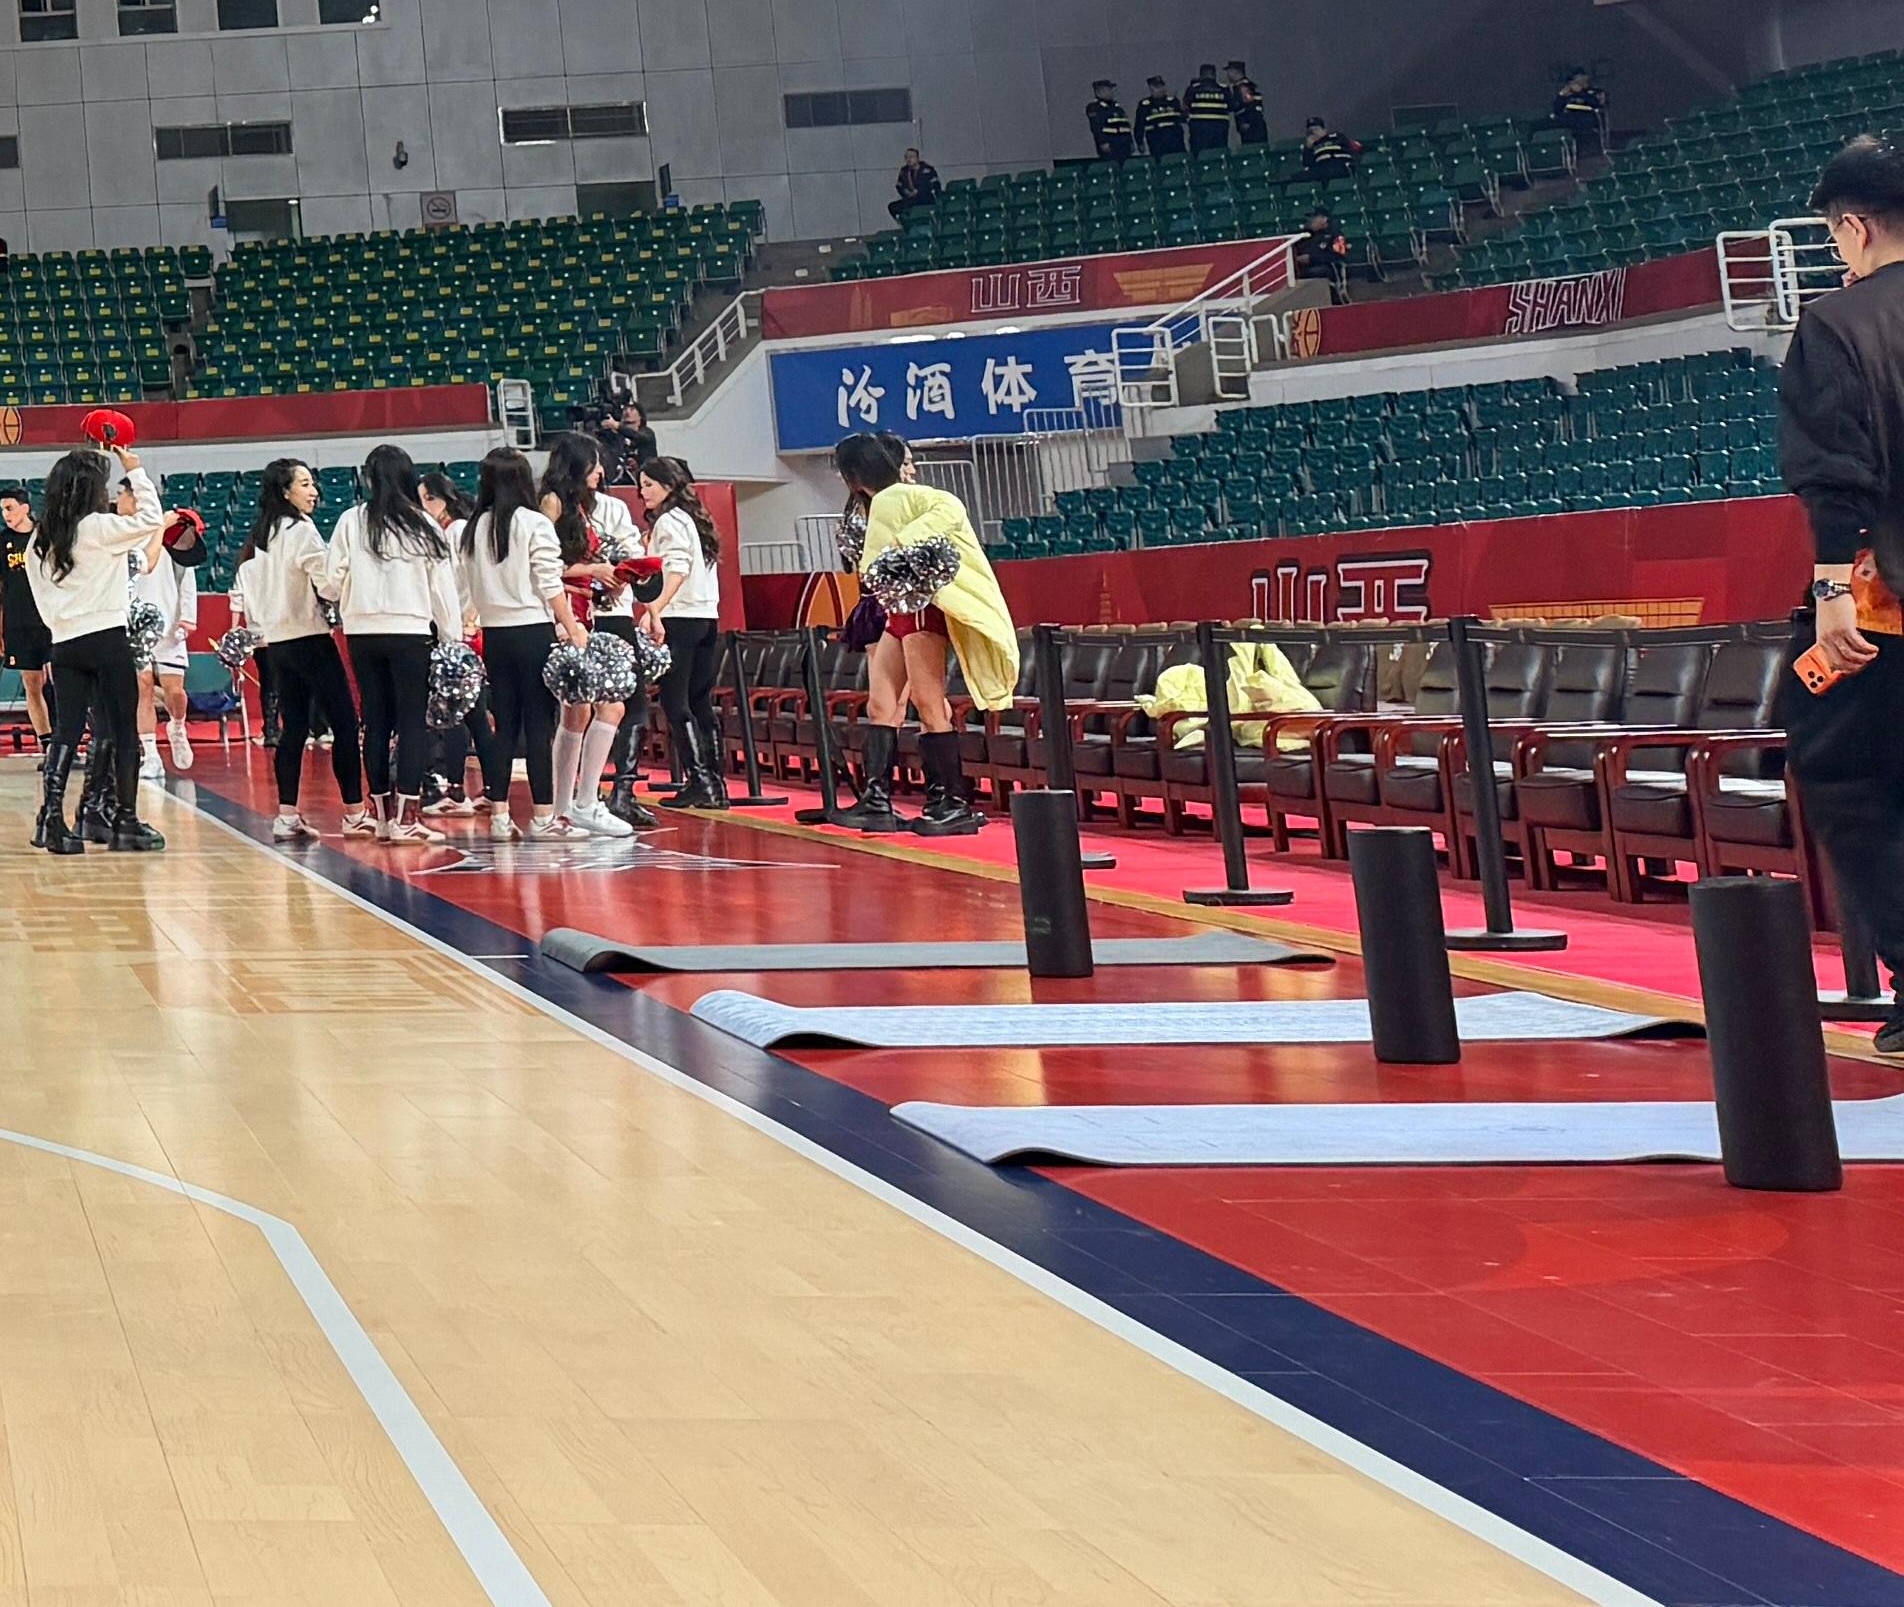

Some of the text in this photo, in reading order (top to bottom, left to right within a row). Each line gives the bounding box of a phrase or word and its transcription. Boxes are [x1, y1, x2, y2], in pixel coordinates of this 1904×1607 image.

[971, 265, 1082, 313] 山西
[1505, 266, 1627, 335] SHANXI
[838, 336, 1192, 428] 汾酒体育
